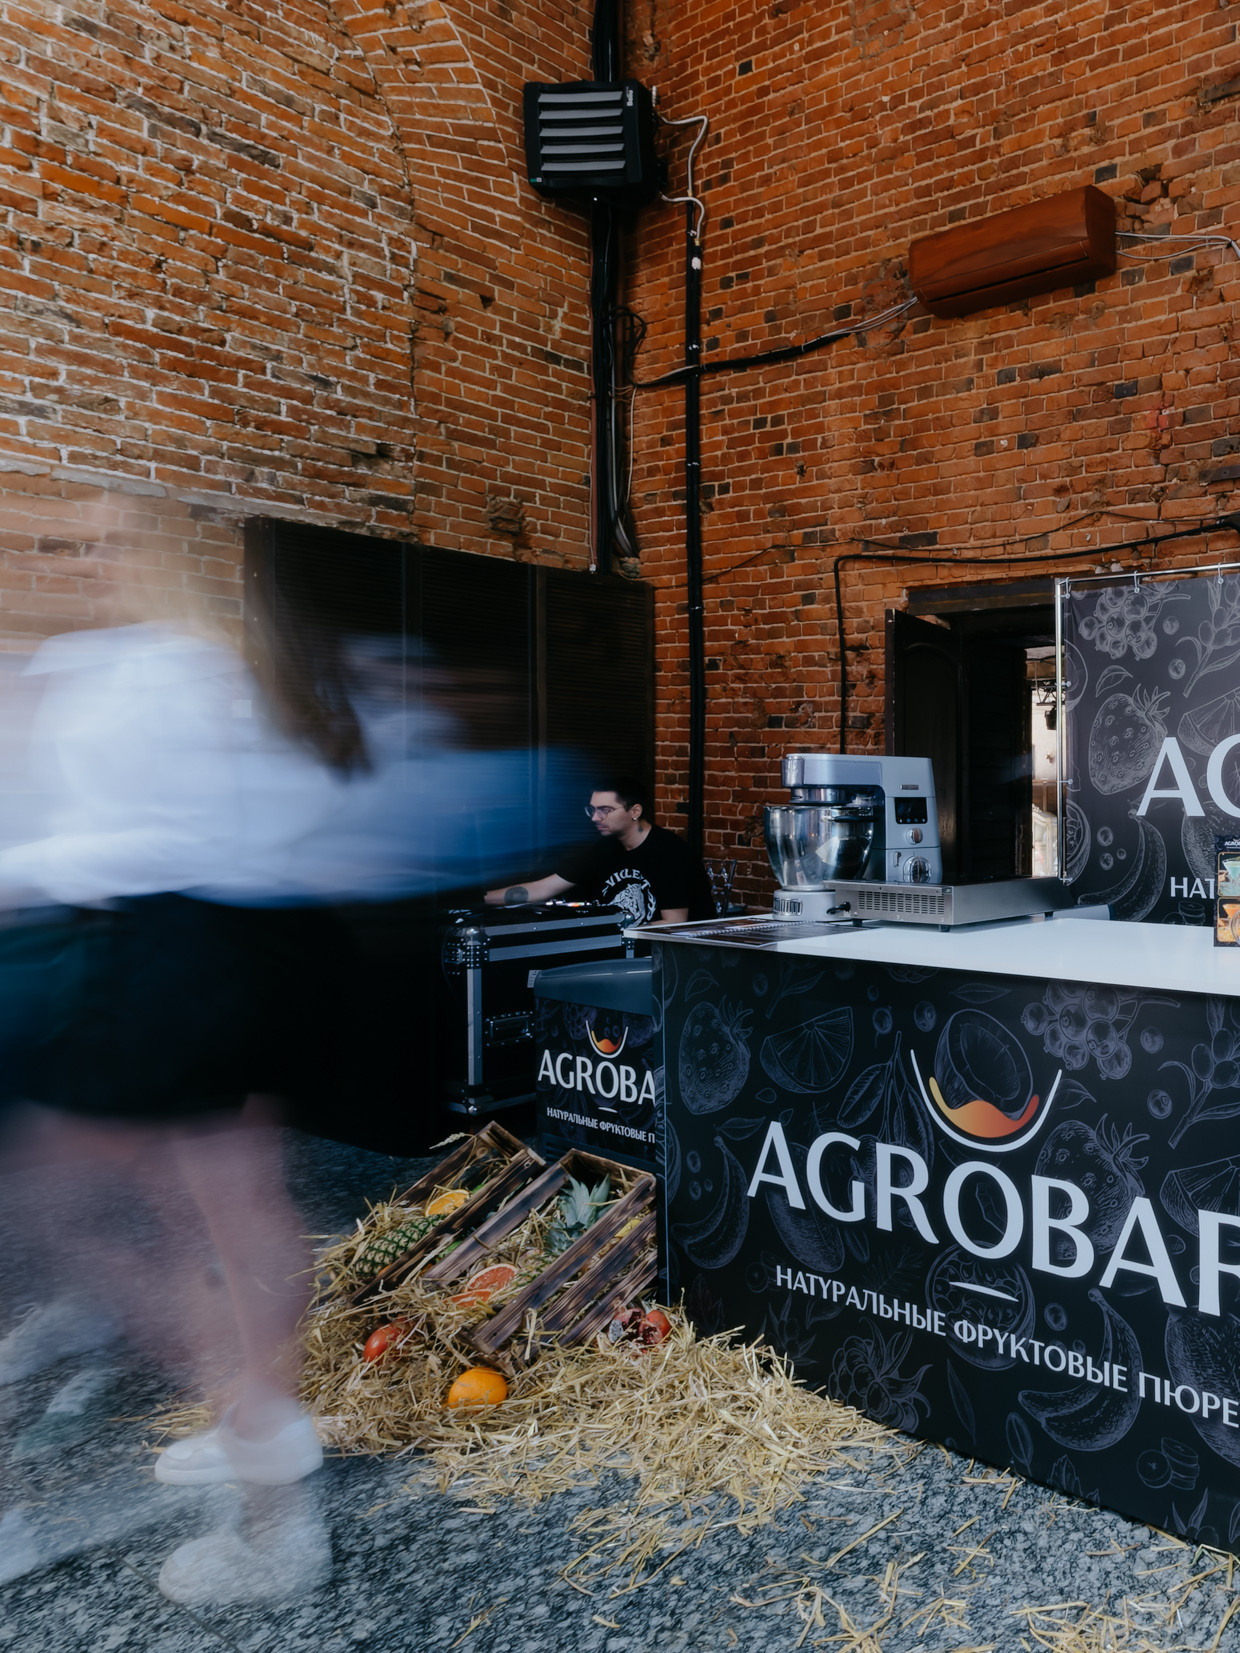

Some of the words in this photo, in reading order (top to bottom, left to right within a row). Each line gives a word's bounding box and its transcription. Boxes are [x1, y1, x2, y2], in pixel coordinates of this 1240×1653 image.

[538, 1049, 656, 1107] AGROBA
[547, 1107, 599, 1129] НАТУРАЛЬНЫЕ
[600, 1121, 647, 1142] ФРУКТОВЫЕ
[776, 1265, 947, 1337] НАТУРАЛЬНЫЕ
[953, 1318, 1128, 1393] ФРУКТОВЫЕ
[1138, 1372, 1240, 1428] ПЮРЕ
